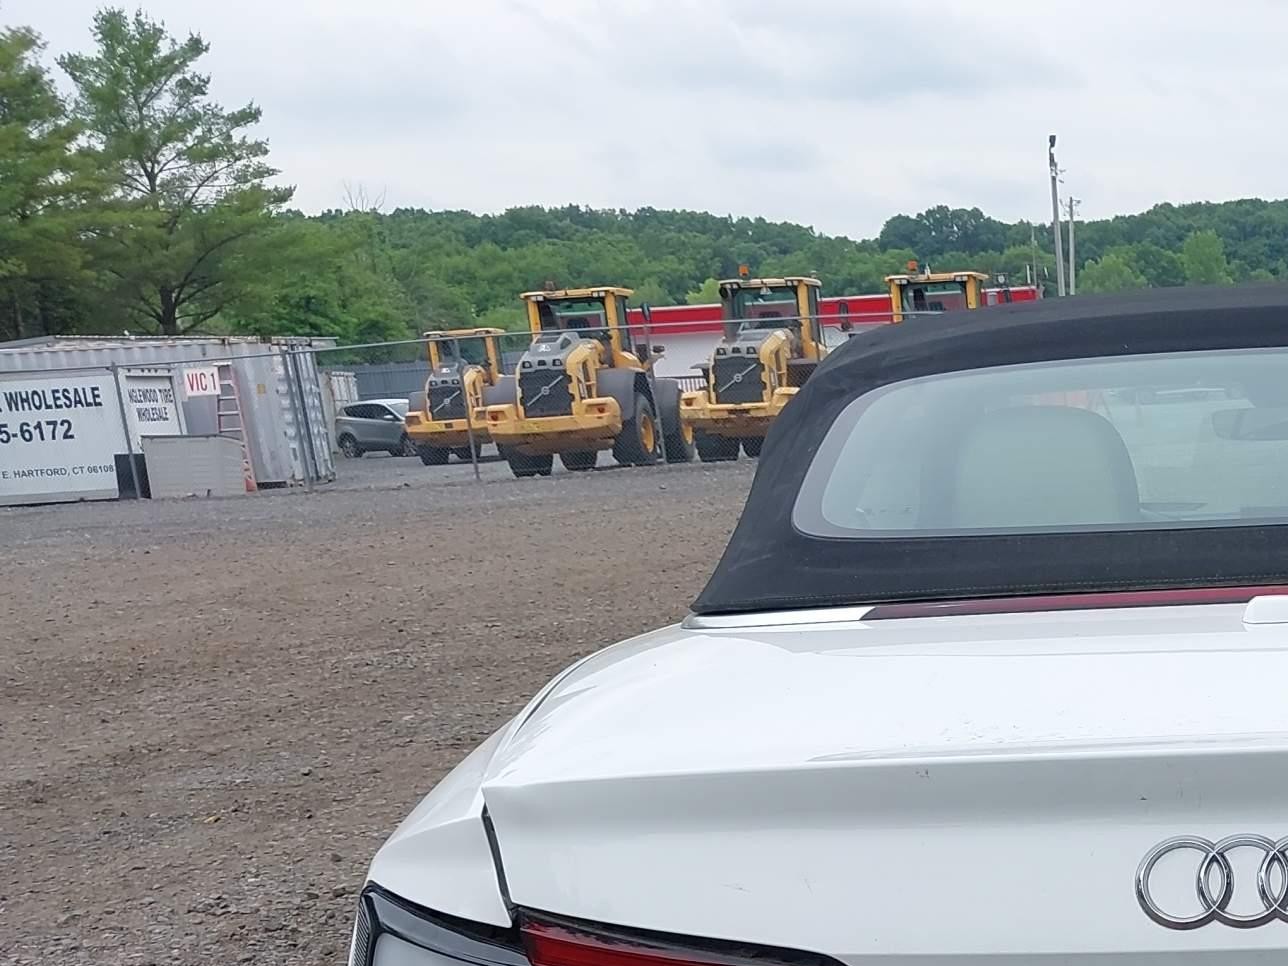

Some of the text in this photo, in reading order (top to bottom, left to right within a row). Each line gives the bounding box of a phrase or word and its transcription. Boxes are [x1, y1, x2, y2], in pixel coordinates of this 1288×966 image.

[186, 372, 217, 392] VIC 1
[3, 386, 103, 412] WHOLESALE
[136, 406, 170, 422] WHOLESALE
[0, 418, 75, 444] 5-6172
[13, 467, 71, 478] HARTFORD,
[72, 465, 85, 475] CT
[87, 463, 115, 474] 06108
